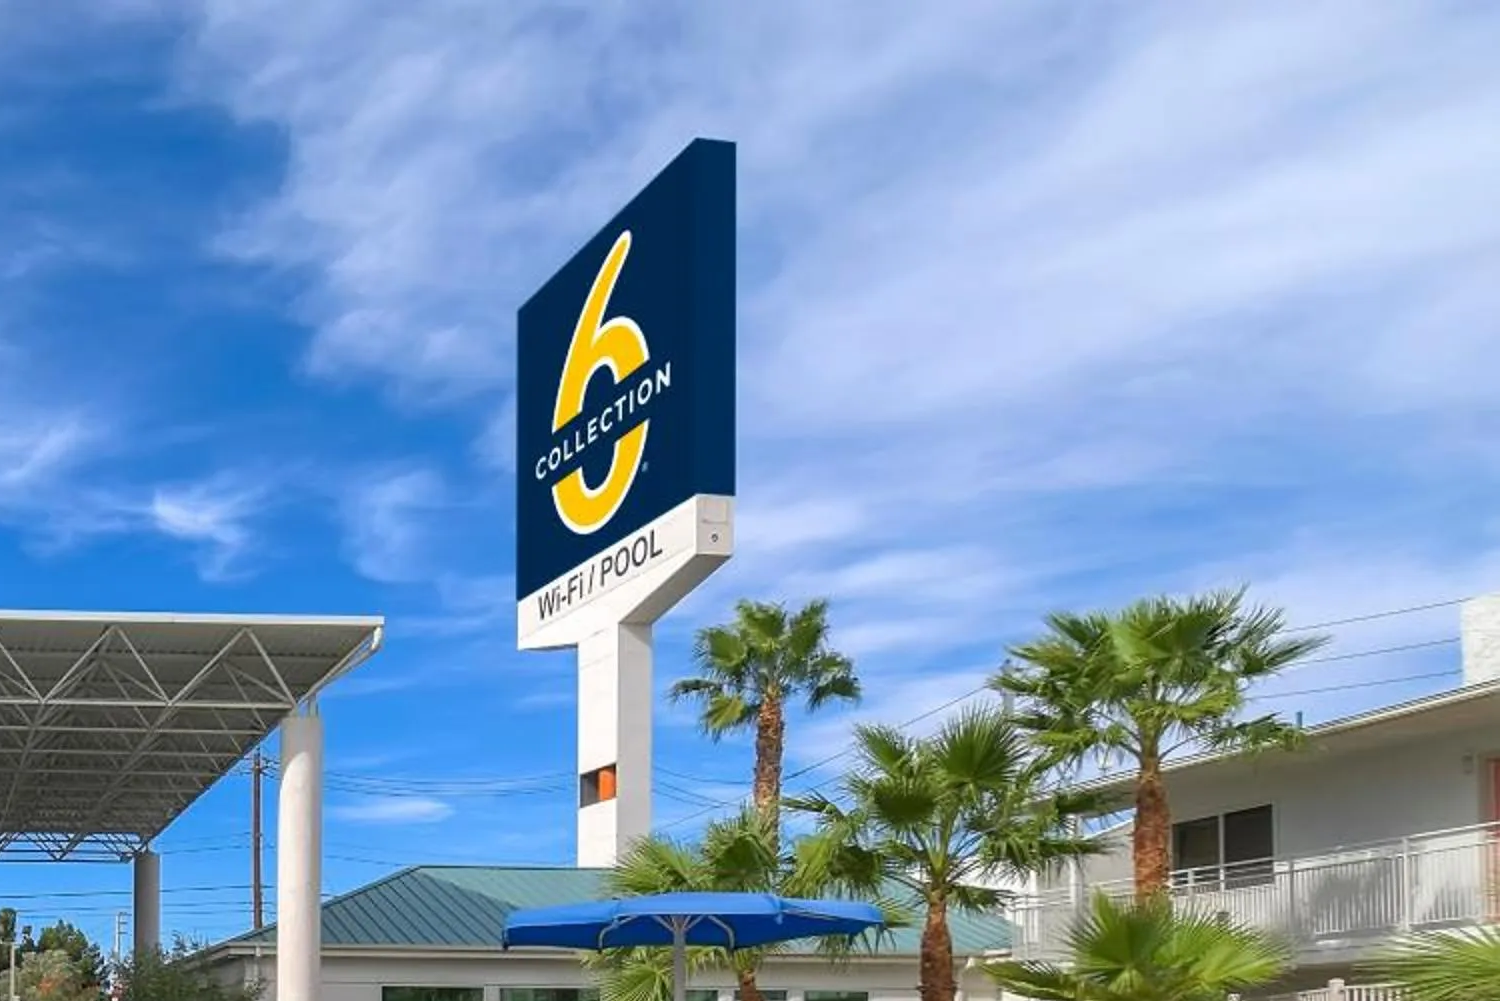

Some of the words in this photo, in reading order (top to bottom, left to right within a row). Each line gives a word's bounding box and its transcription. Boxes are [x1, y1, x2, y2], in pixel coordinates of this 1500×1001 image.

[535, 360, 671, 480] COLLECTION
[552, 230, 650, 534] 6
[538, 571, 583, 620] Wi-Fi
[601, 528, 663, 587] POOL
